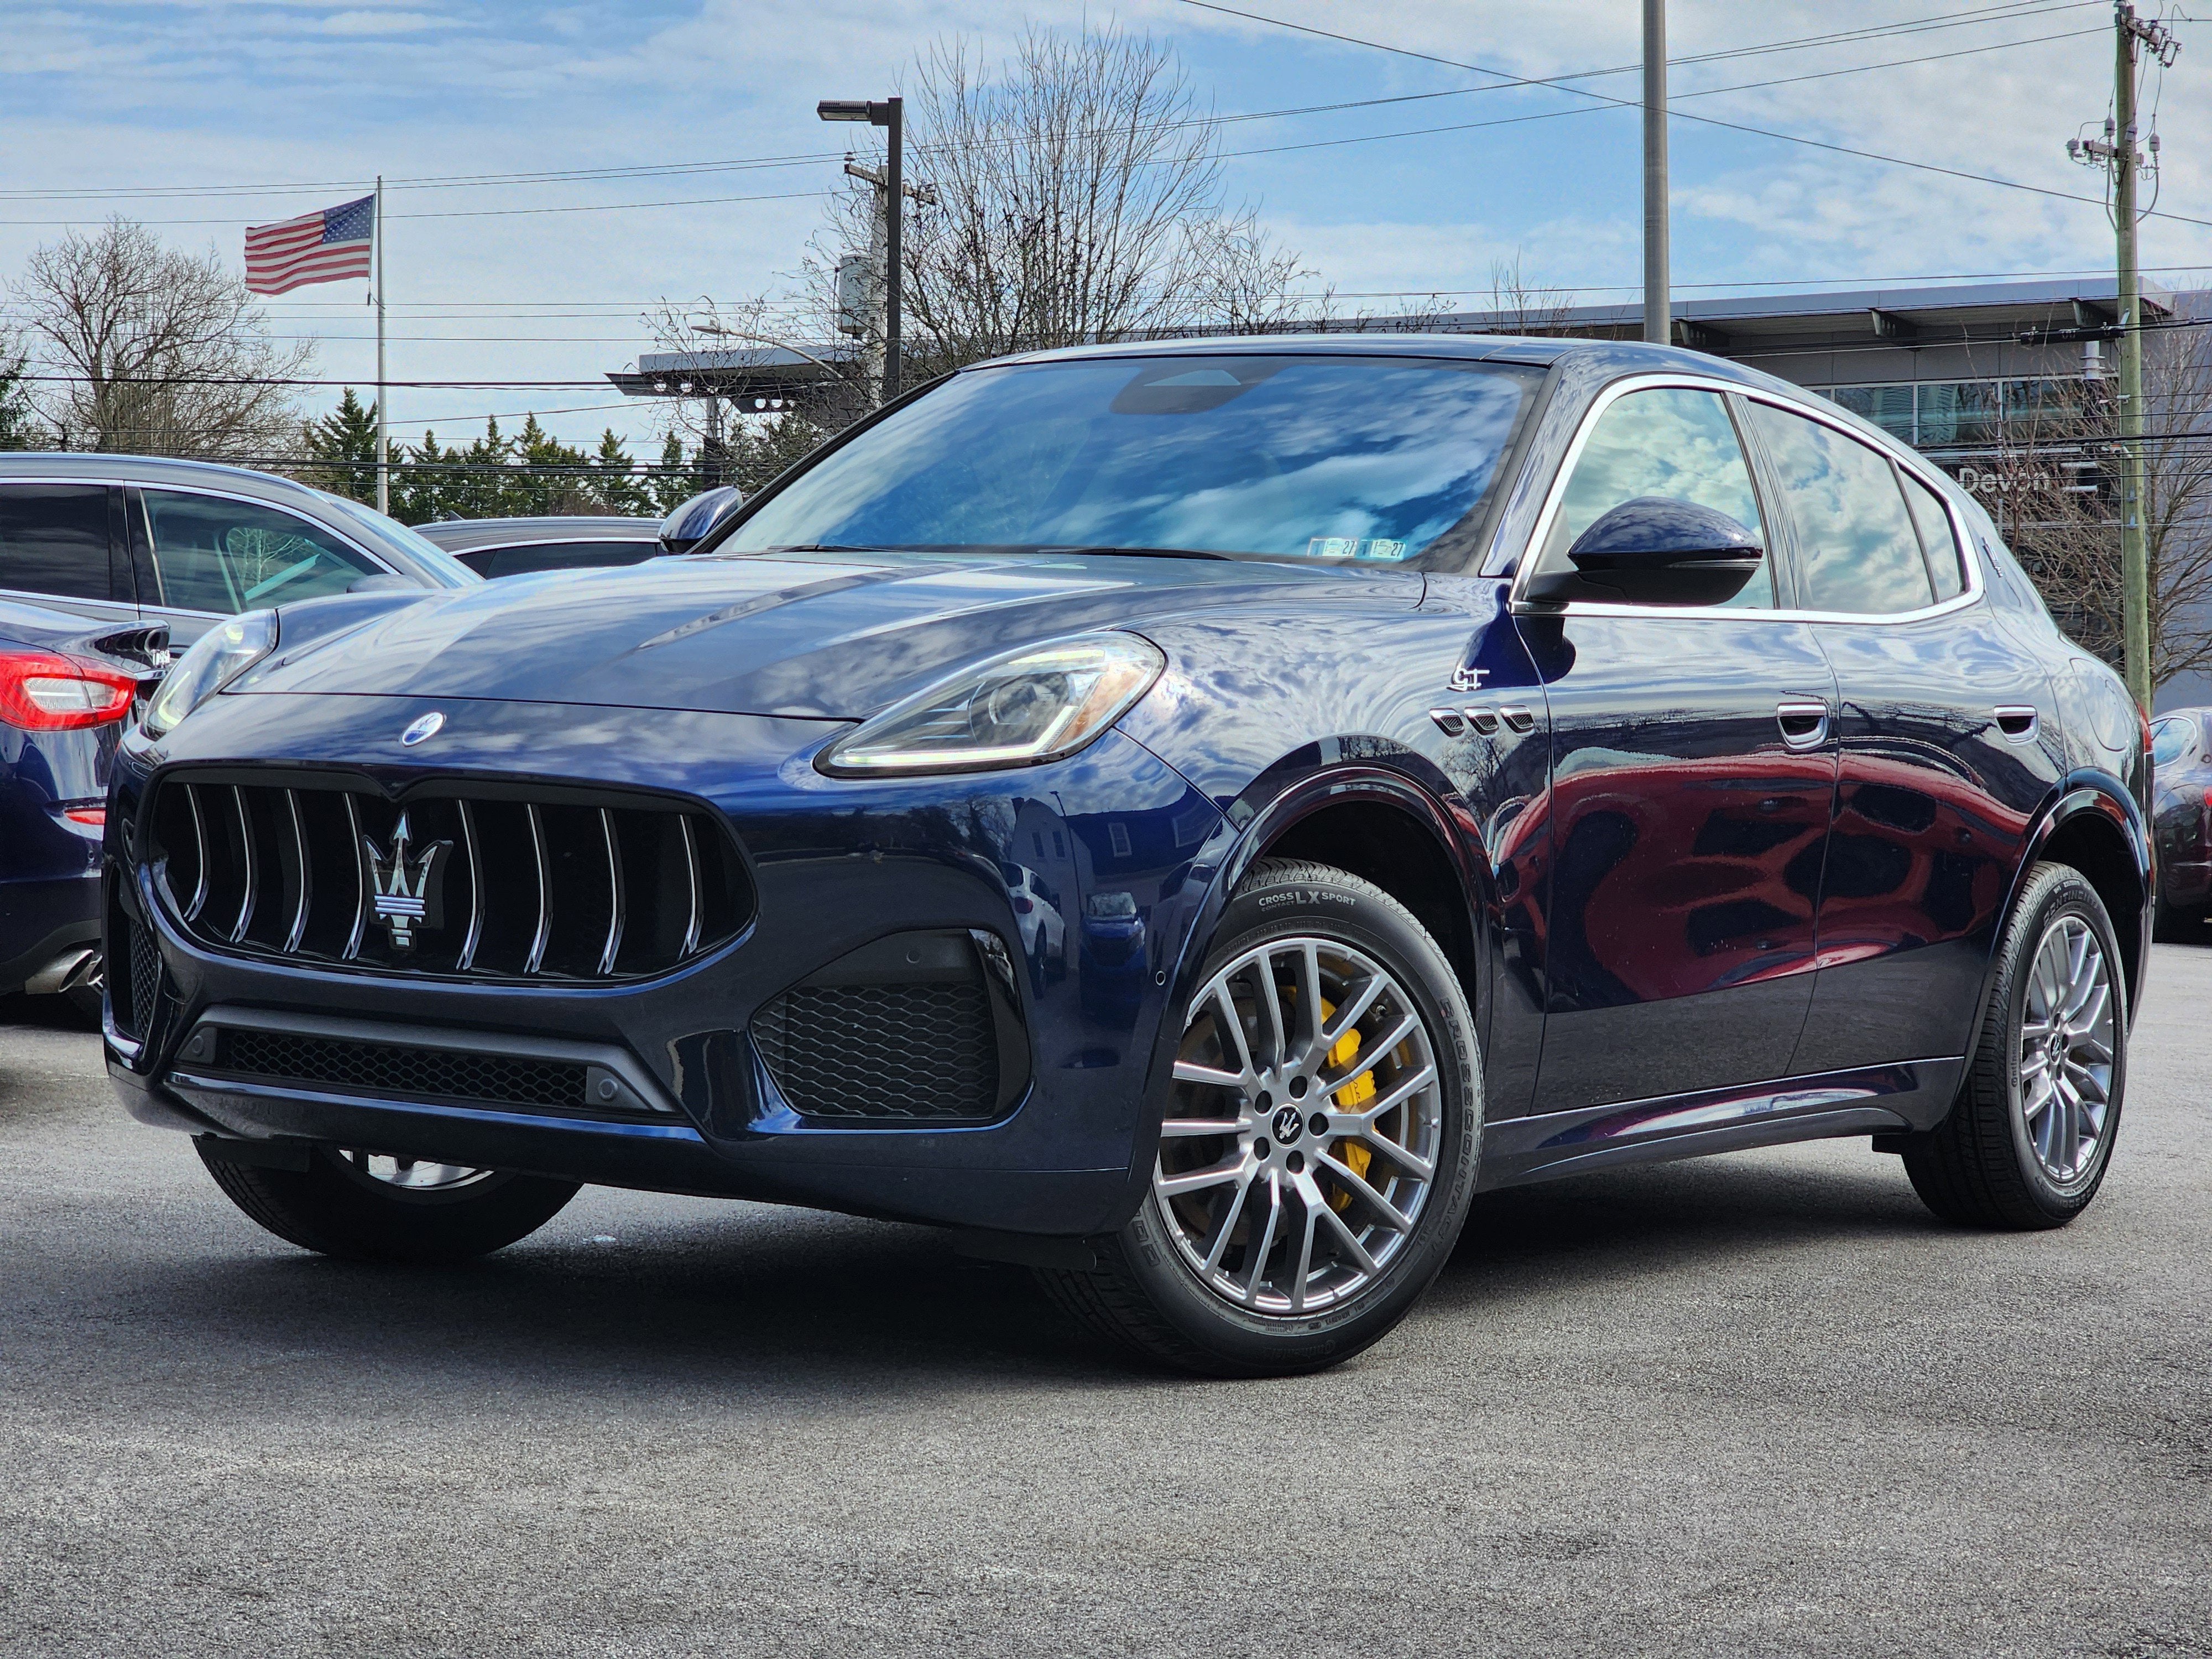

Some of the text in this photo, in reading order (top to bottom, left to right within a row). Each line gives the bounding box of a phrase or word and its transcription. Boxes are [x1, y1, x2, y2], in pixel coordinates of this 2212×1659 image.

[1959, 468, 2050, 493] Devon
[1343, 541, 1355, 555] 27
[1391, 542, 1404, 557] 27
[1447, 668, 1490, 691] GT
[1259, 893, 1294, 906] CROSS
[1322, 893, 1355, 906] SPORT
[1261, 900, 1294, 912] CONTACT
[1430, 997, 1474, 1256] CROSSCONTACT
